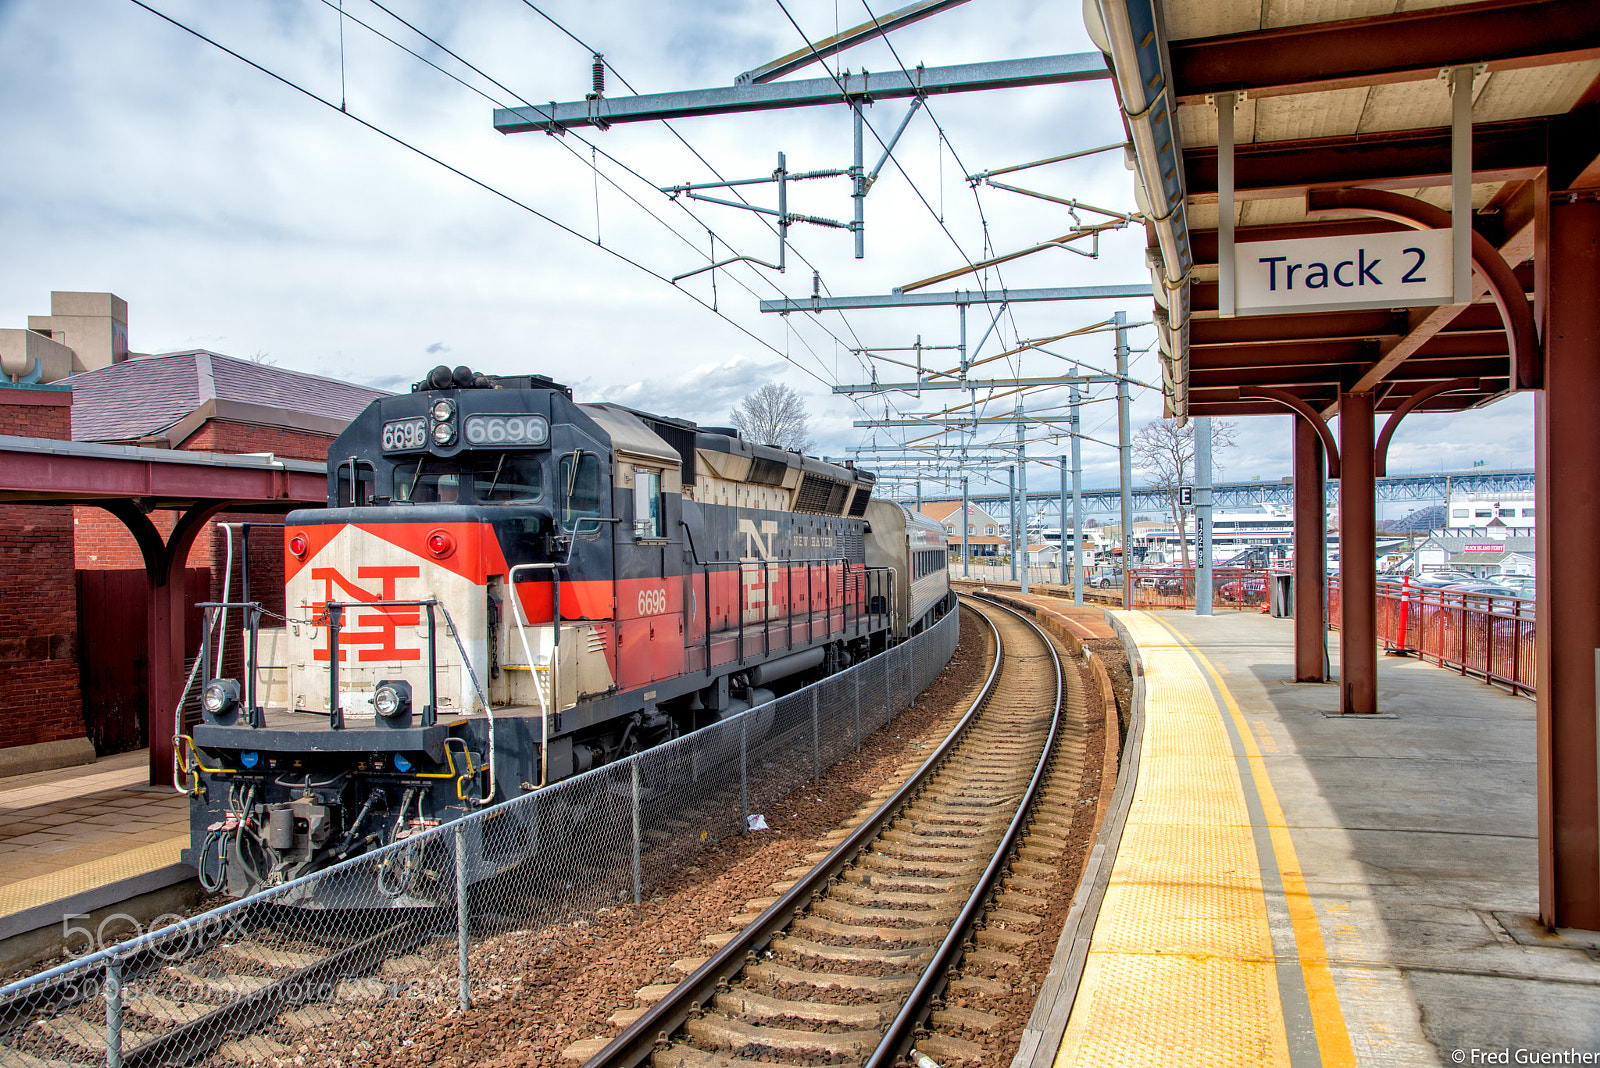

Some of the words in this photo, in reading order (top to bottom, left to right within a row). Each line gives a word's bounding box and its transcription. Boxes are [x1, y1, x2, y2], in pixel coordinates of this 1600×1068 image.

[1258, 248, 1383, 291] Track
[1401, 247, 1427, 284] 2
[382, 421, 426, 449] 6696
[466, 418, 544, 443] 6696
[1181, 488, 1191, 504] E
[793, 535, 808, 547] NEW
[811, 536, 833, 547] HAVEN
[638, 588, 666, 616] 6696
